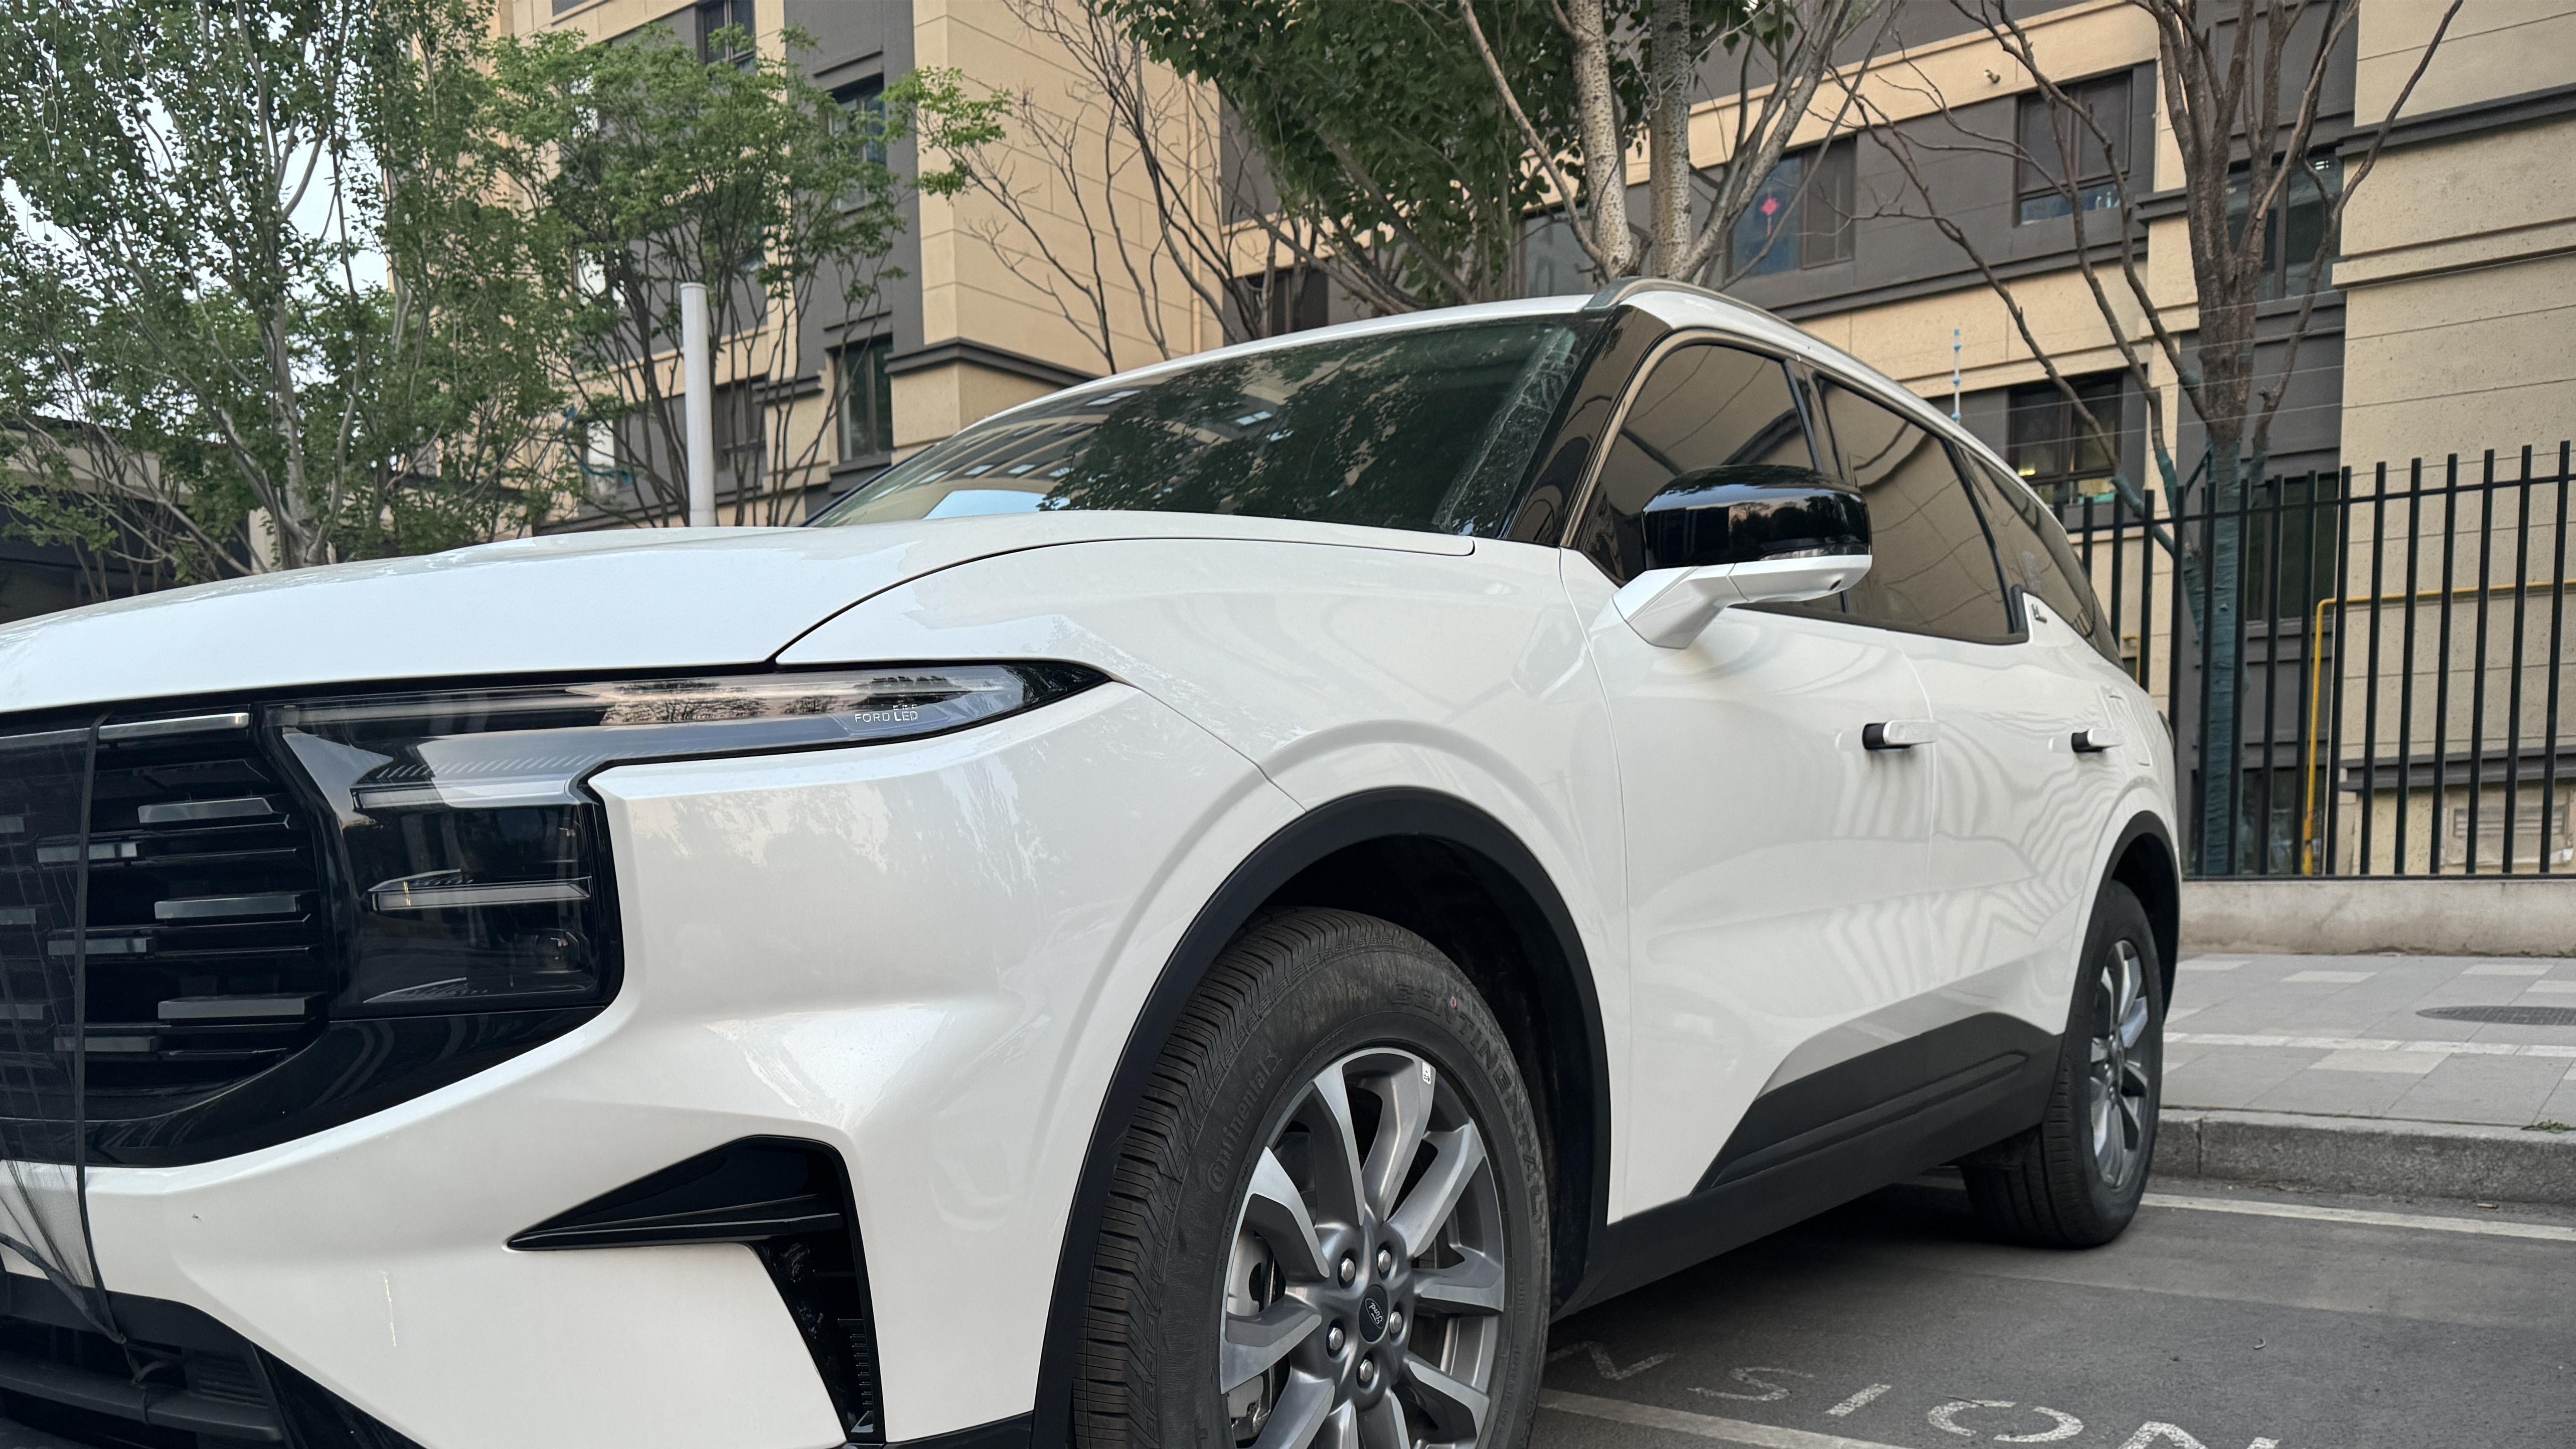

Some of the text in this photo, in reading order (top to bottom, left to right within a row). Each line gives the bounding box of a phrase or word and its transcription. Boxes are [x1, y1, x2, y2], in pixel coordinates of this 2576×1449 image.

[854, 711, 919, 723] FORD LED
[1207, 1057, 1272, 1194] Continental
[1368, 1302, 1383, 1325] Ford
